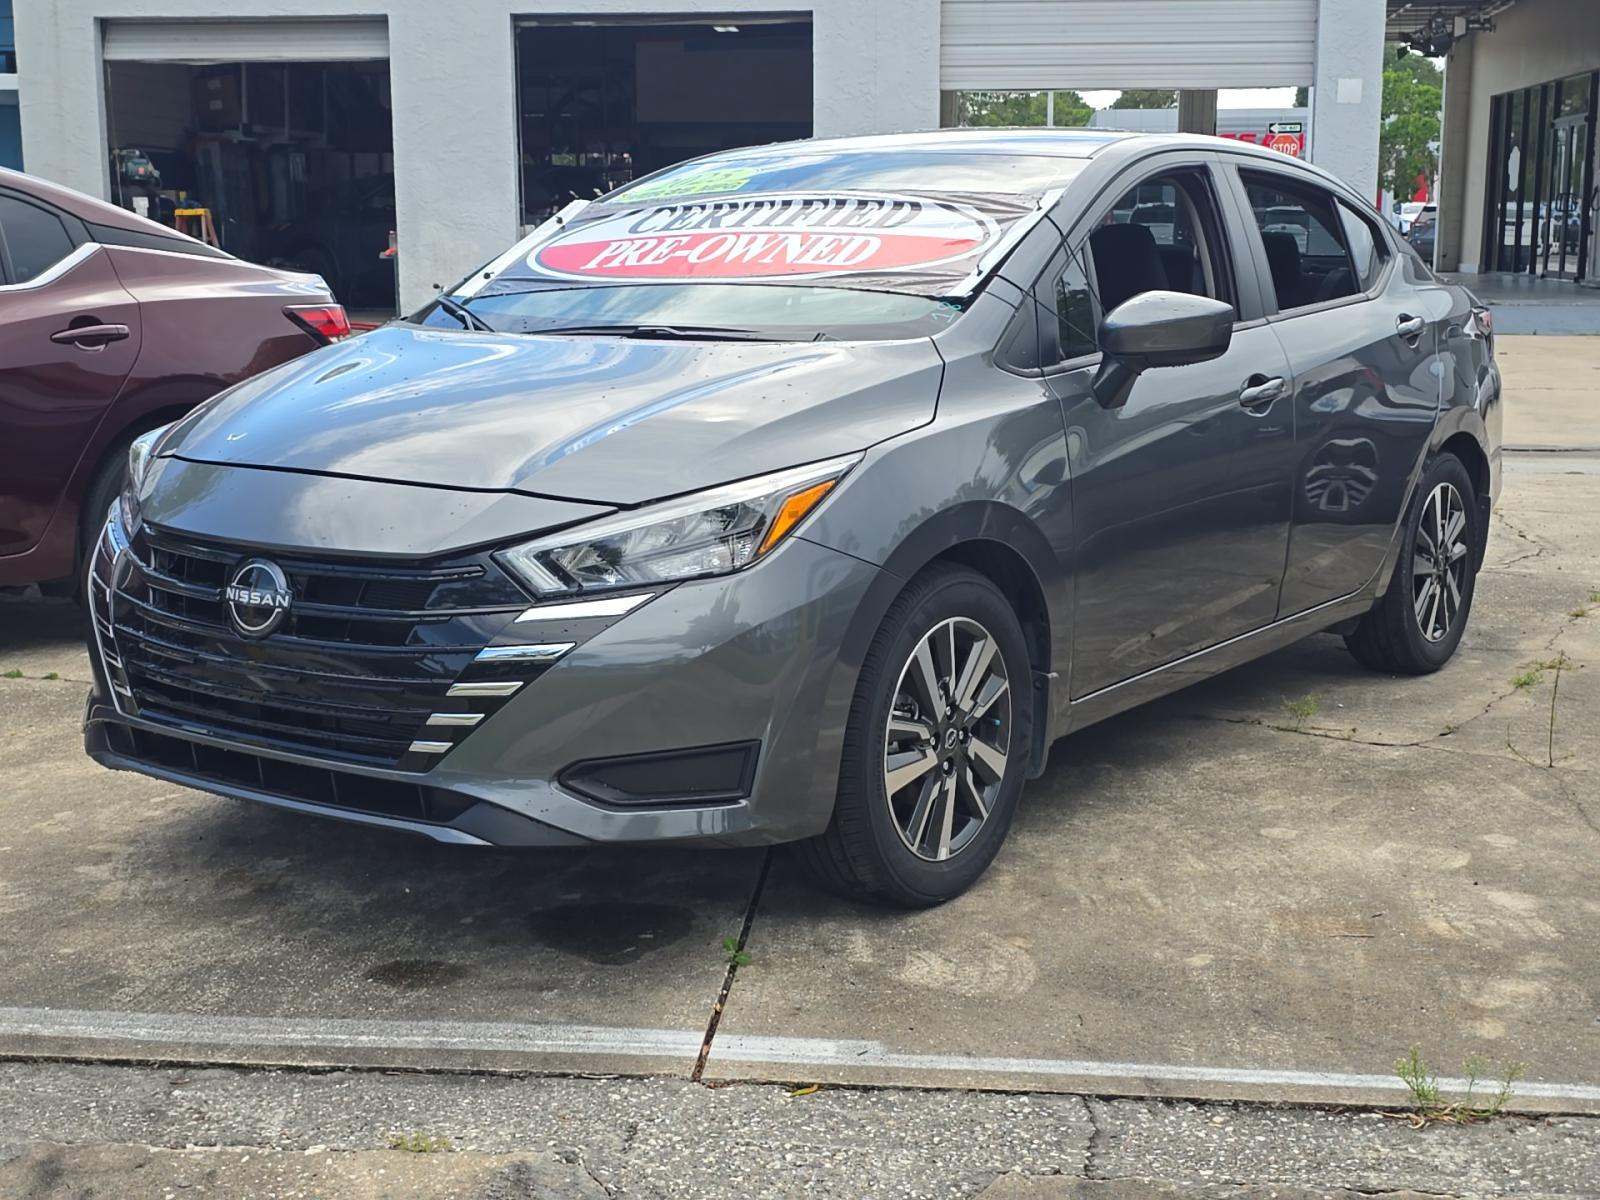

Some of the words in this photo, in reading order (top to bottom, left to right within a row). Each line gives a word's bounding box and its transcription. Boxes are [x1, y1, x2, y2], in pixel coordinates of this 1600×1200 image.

[1272, 143, 1297, 155] STOP
[629, 198, 922, 234] CERTIFIED
[582, 232, 881, 271] PRE-OWNED
[225, 586, 290, 608] NISSAN
